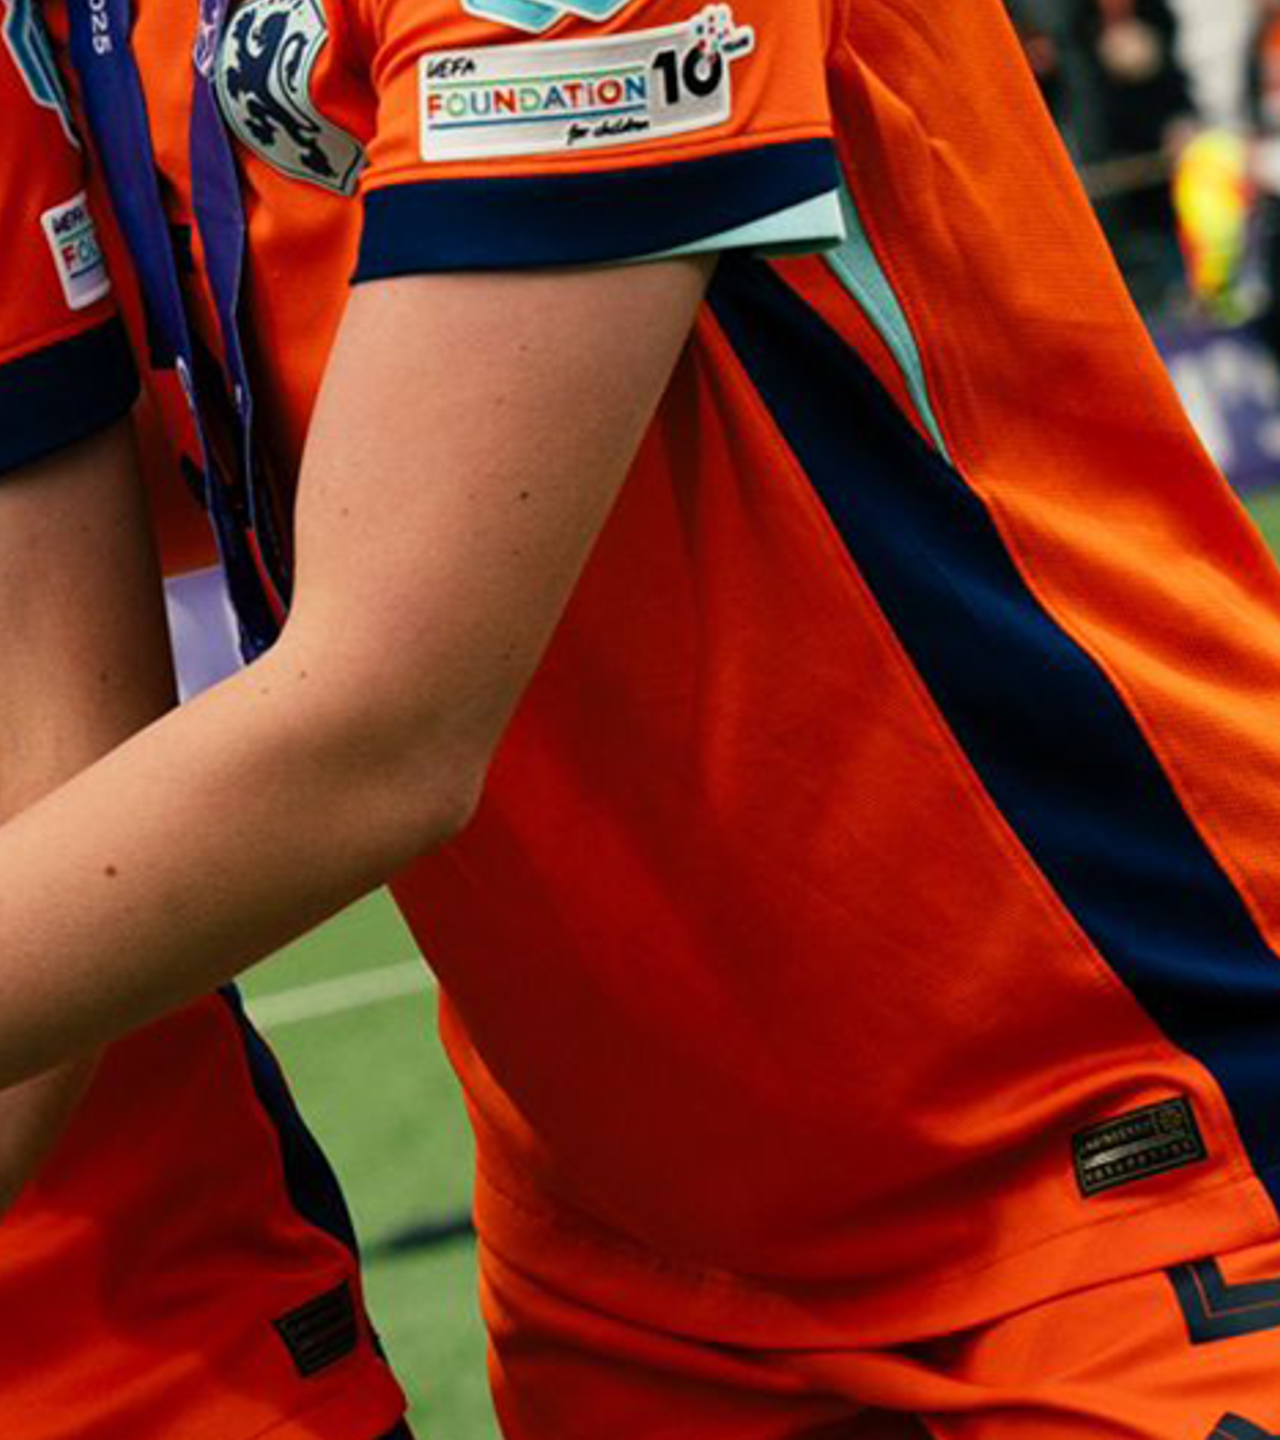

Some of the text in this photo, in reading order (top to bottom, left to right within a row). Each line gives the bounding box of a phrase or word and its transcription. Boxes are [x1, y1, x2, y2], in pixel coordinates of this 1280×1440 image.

[427, 57, 476, 80] UEFA
[652, 40, 723, 106] 10
[427, 74, 647, 118] FOUNDATION
[593, 117, 650, 140] children
